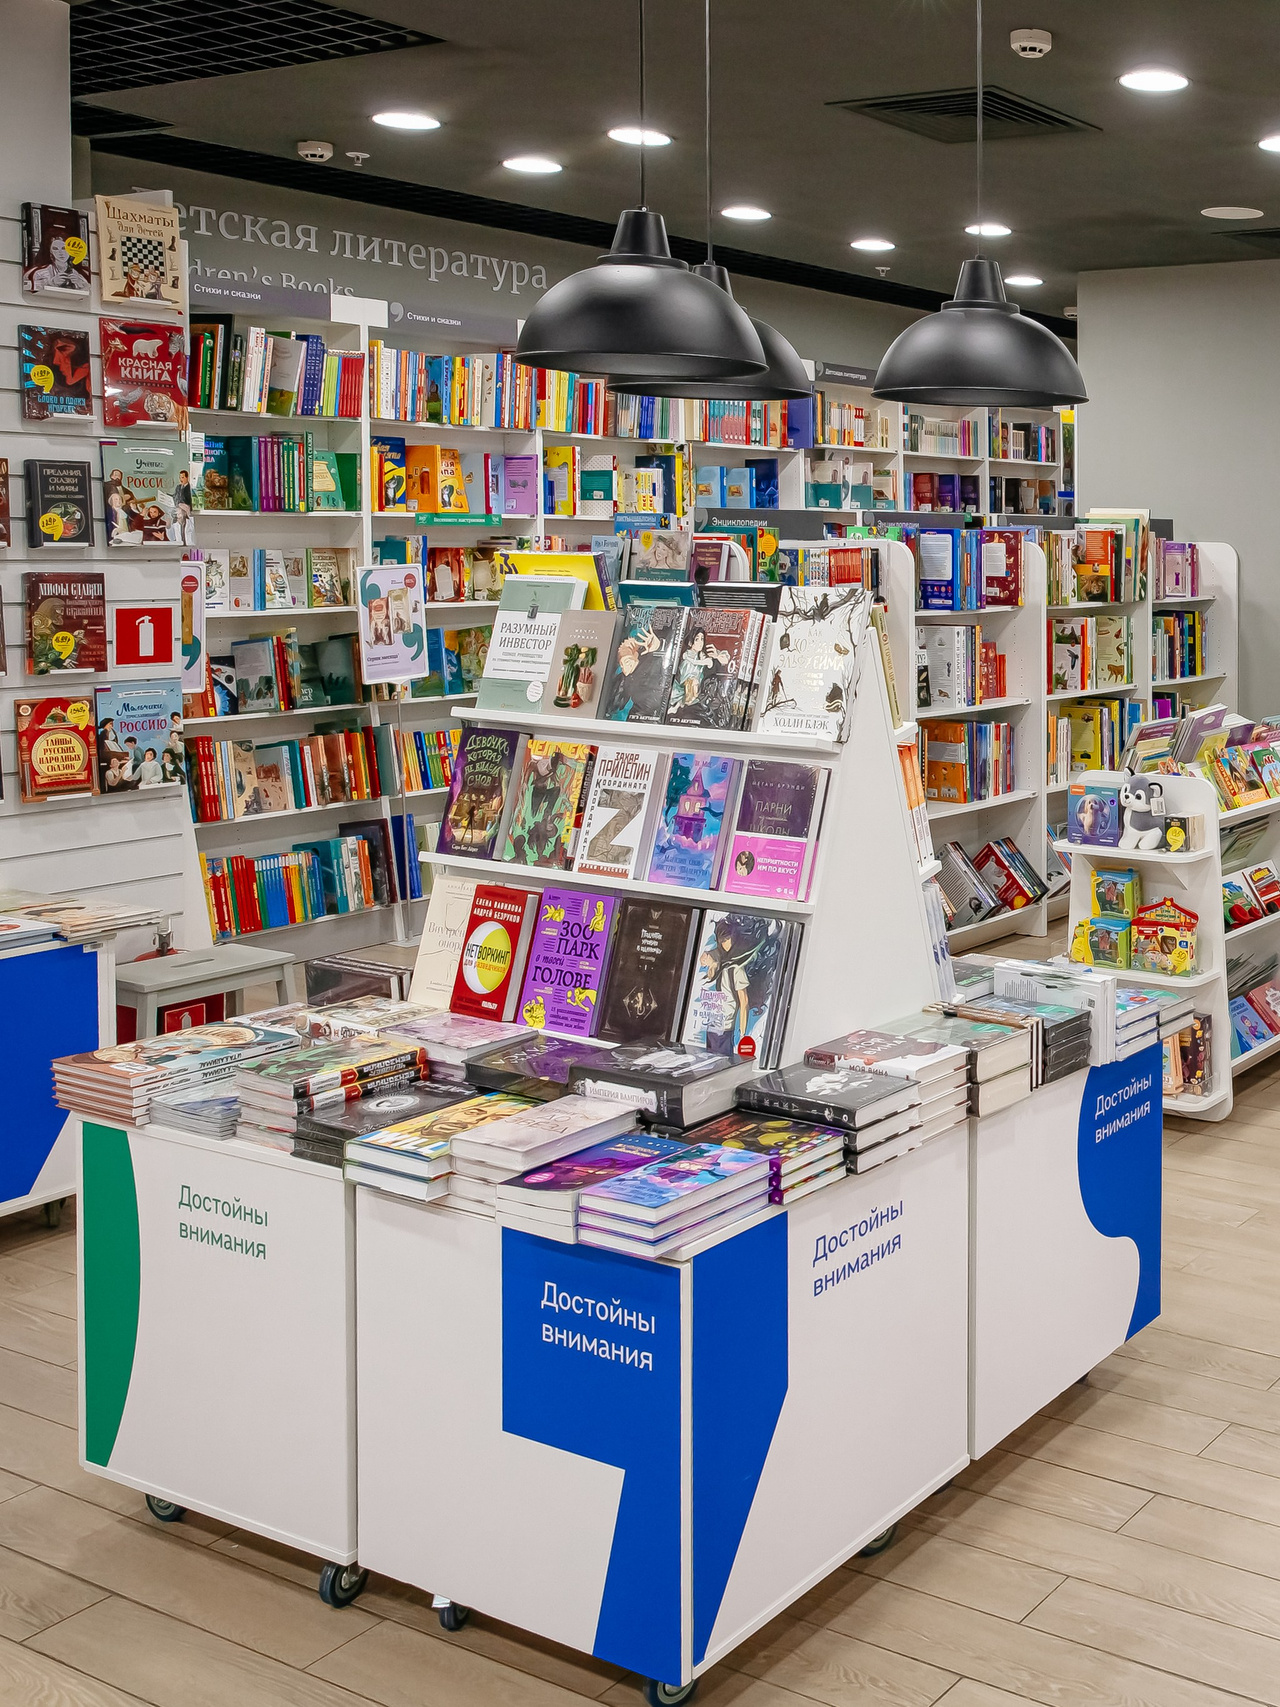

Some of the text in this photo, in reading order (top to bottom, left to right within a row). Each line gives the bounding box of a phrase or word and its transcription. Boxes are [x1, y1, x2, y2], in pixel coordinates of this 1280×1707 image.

[106, 201, 175, 228] Шахматы
[117, 221, 164, 238] для детей
[176, 202, 549, 295] етская литература
[193, 283, 261, 301] Стихи и сказки
[407, 311, 428, 322] Стихи
[437, 317, 462, 327] сказки
[118, 357, 172, 371] КРАСНАЯ
[120, 367, 172, 382] КНИГА
[711, 515, 768, 528] Энциклопедии
[38, 583, 69, 599] МИФЫ
[500, 622, 557, 636] РАЗУМНЫЙ
[498, 636, 552, 651] ИНВЕСТОР
[779, 654, 845, 671] ЭЛЬФХЕЙМА
[119, 719, 167, 734] РОССИЮ
[773, 716, 829, 731] ХОЛЛИ БЛЭК
[45, 738, 72, 747] ТАЙНЫ
[43, 747, 76, 755] РУССКИХ
[467, 750, 502, 764] КОТОРАЯ
[615, 751, 640, 762] ЗАХАР
[39, 754, 82, 765] НАРОДНЫХ
[47, 763, 75, 772] СКАЗОК
[465, 765, 501, 778] НЕ ВИДЕЛА
[600, 759, 652, 781] ПРИЛЕПИН
[466, 775, 493, 787] СНОВ
[596, 778, 648, 790] КООРДИНАТА
[777, 783, 806, 791] БРЭНДИ
[755, 800, 794, 815] ПАРНИ
[757, 857, 799, 869] НЕПРИЯТНОСТИ
[778, 866, 798, 875] ВКУСУ
[475, 897, 522, 913] ЕЛЕНА ВАВИЛОВА
[473, 908, 521, 923] АНДРЕЙ БЕЗРУКОВ
[560, 921, 595, 940] ЗОО
[465, 943, 510, 965] НЕТВОРКИНГ
[555, 938, 600, 961] ПАРК
[464, 959, 506, 973] ДЛЯ РАЗВЕДЧИКОВ
[535, 954, 565, 967] в твоей
[532, 966, 592, 990] ГОЛОВЕ
[849, 1064, 889, 1077] МОЯ ВИНА
[589, 1086, 654, 1107] ИМПЕРИЯ ВАМПИРОВ
[1095, 1073, 1152, 1120] Достойны
[1094, 1099, 1151, 1144] внимания
[178, 1184, 268, 1228] Достойны
[179, 1220, 267, 1261] внимания
[813, 1199, 904, 1267] Достойны
[813, 1233, 903, 1298] внимания
[542, 1281, 656, 1335] Достойны
[542, 1322, 654, 1372] внимания
